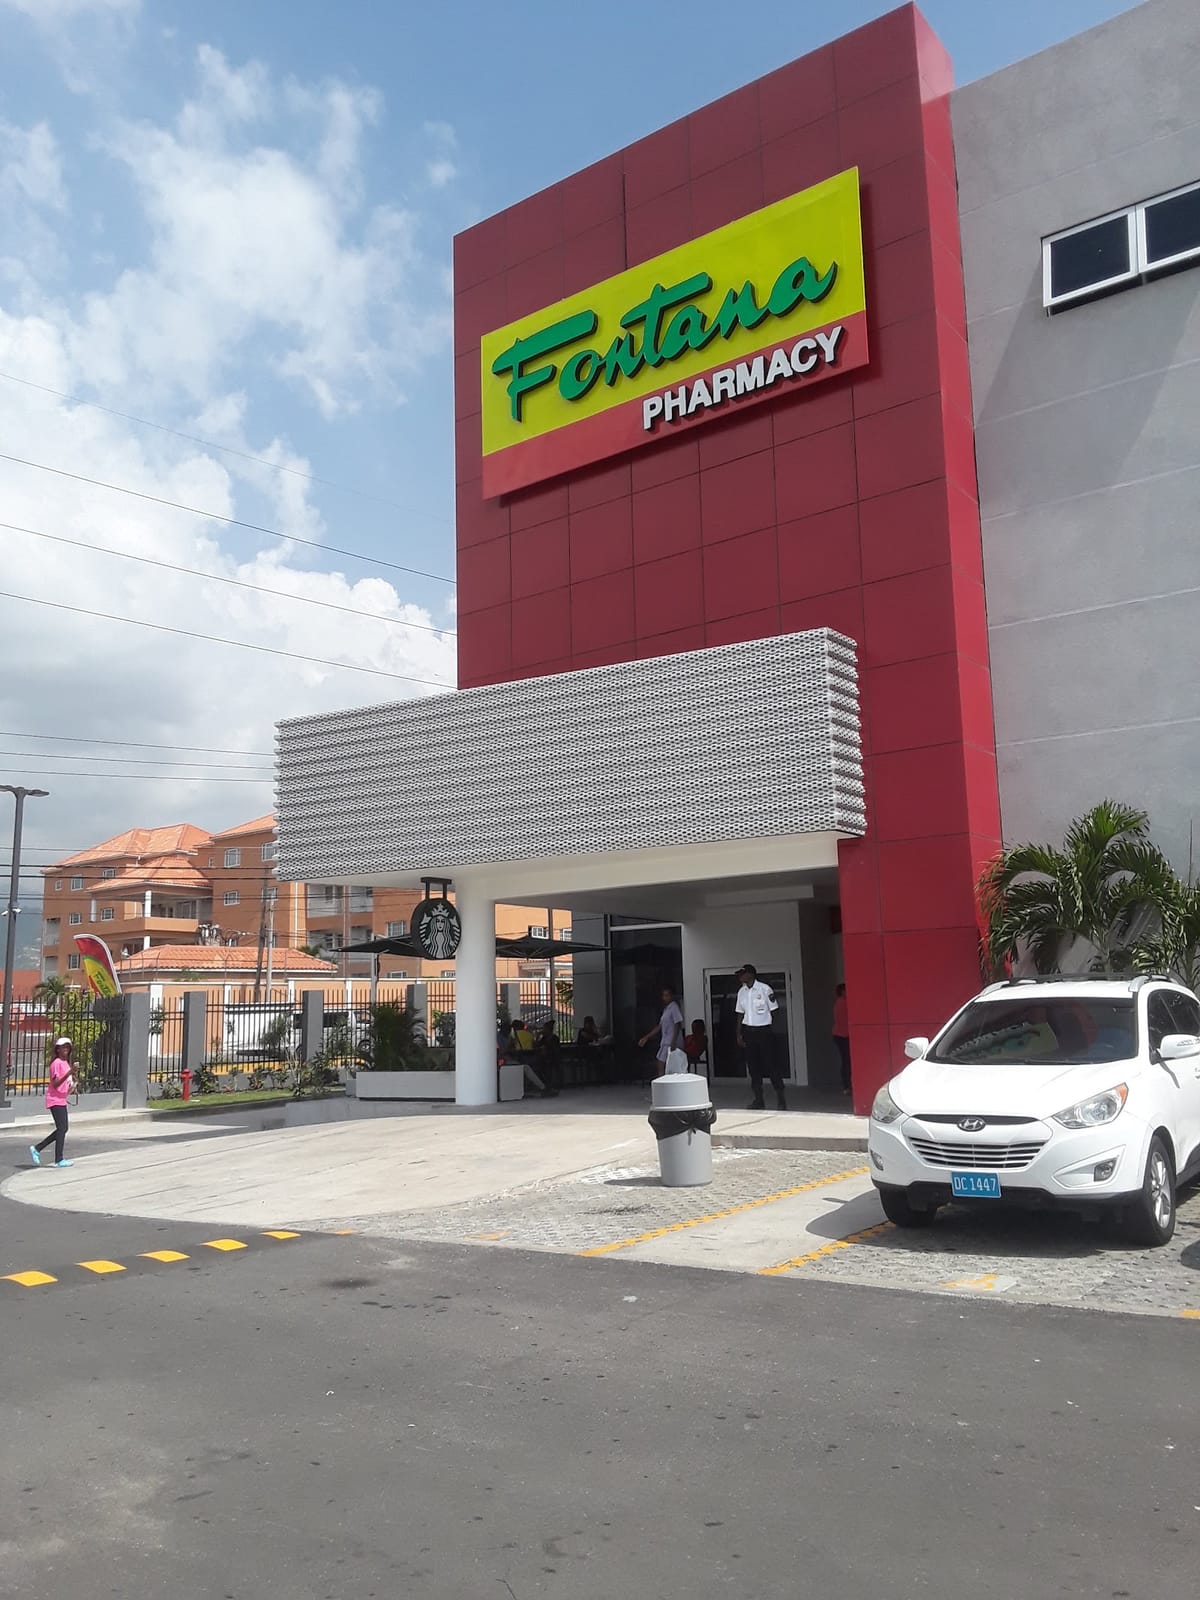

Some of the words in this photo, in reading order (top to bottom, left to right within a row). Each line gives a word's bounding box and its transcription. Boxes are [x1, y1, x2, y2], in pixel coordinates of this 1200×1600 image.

[491, 256, 838, 421] Fontana
[642, 325, 844, 431] PHARMACY
[953, 1176, 968, 1190] DC
[970, 1177, 996, 1191] 1447
